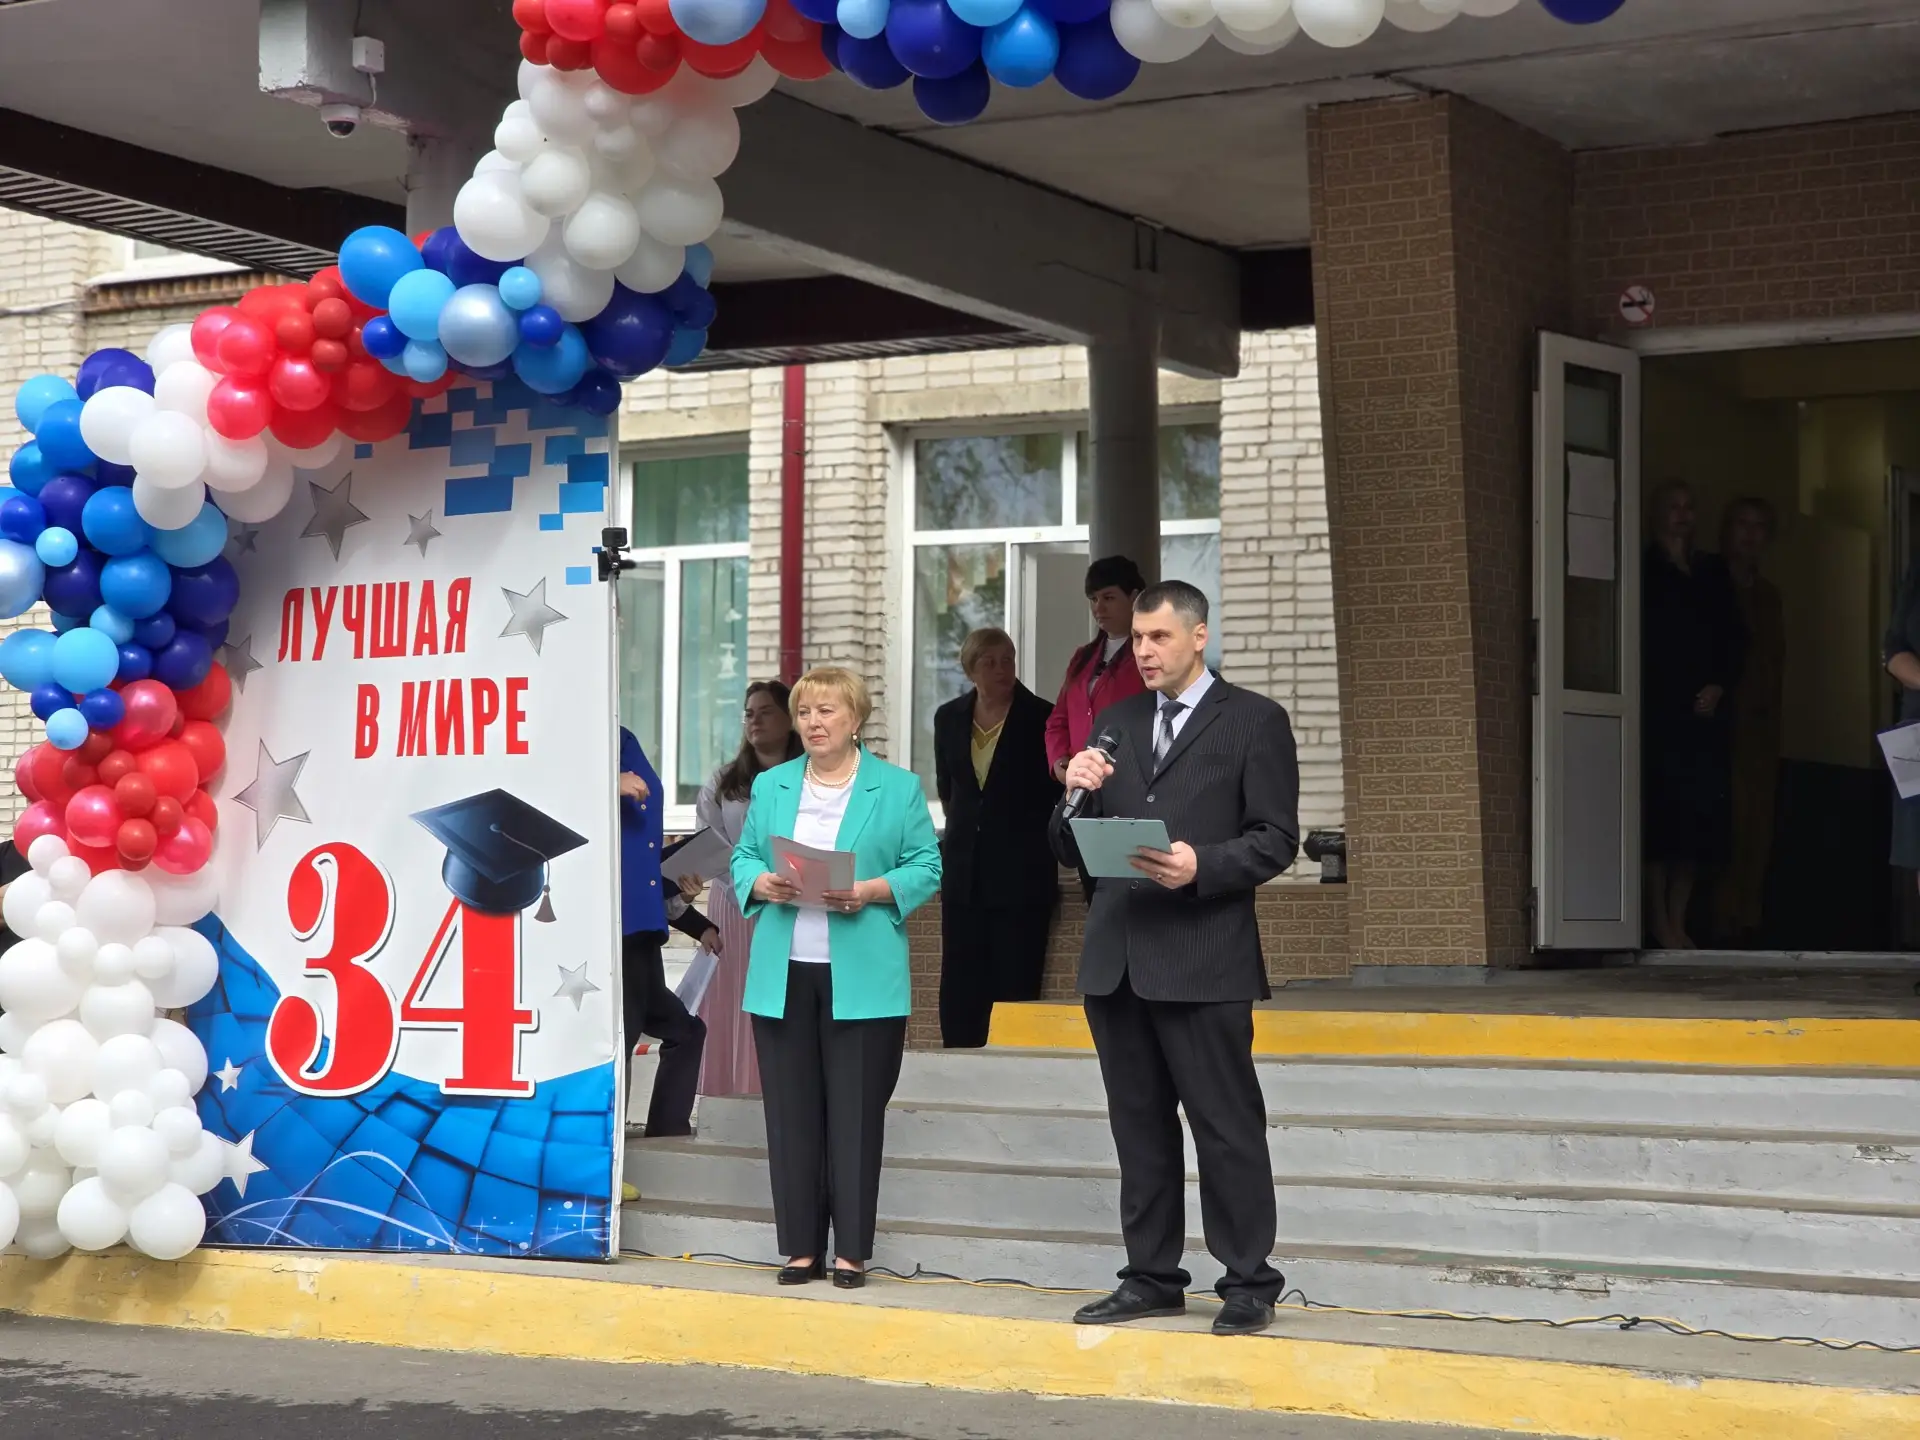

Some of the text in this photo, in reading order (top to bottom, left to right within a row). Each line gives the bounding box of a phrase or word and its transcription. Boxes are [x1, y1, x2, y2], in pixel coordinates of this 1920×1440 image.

[277, 577, 472, 662] ЛУЧШАЯ
[354, 677, 529, 760] В МИРЕ
[268, 841, 535, 1096] 34
